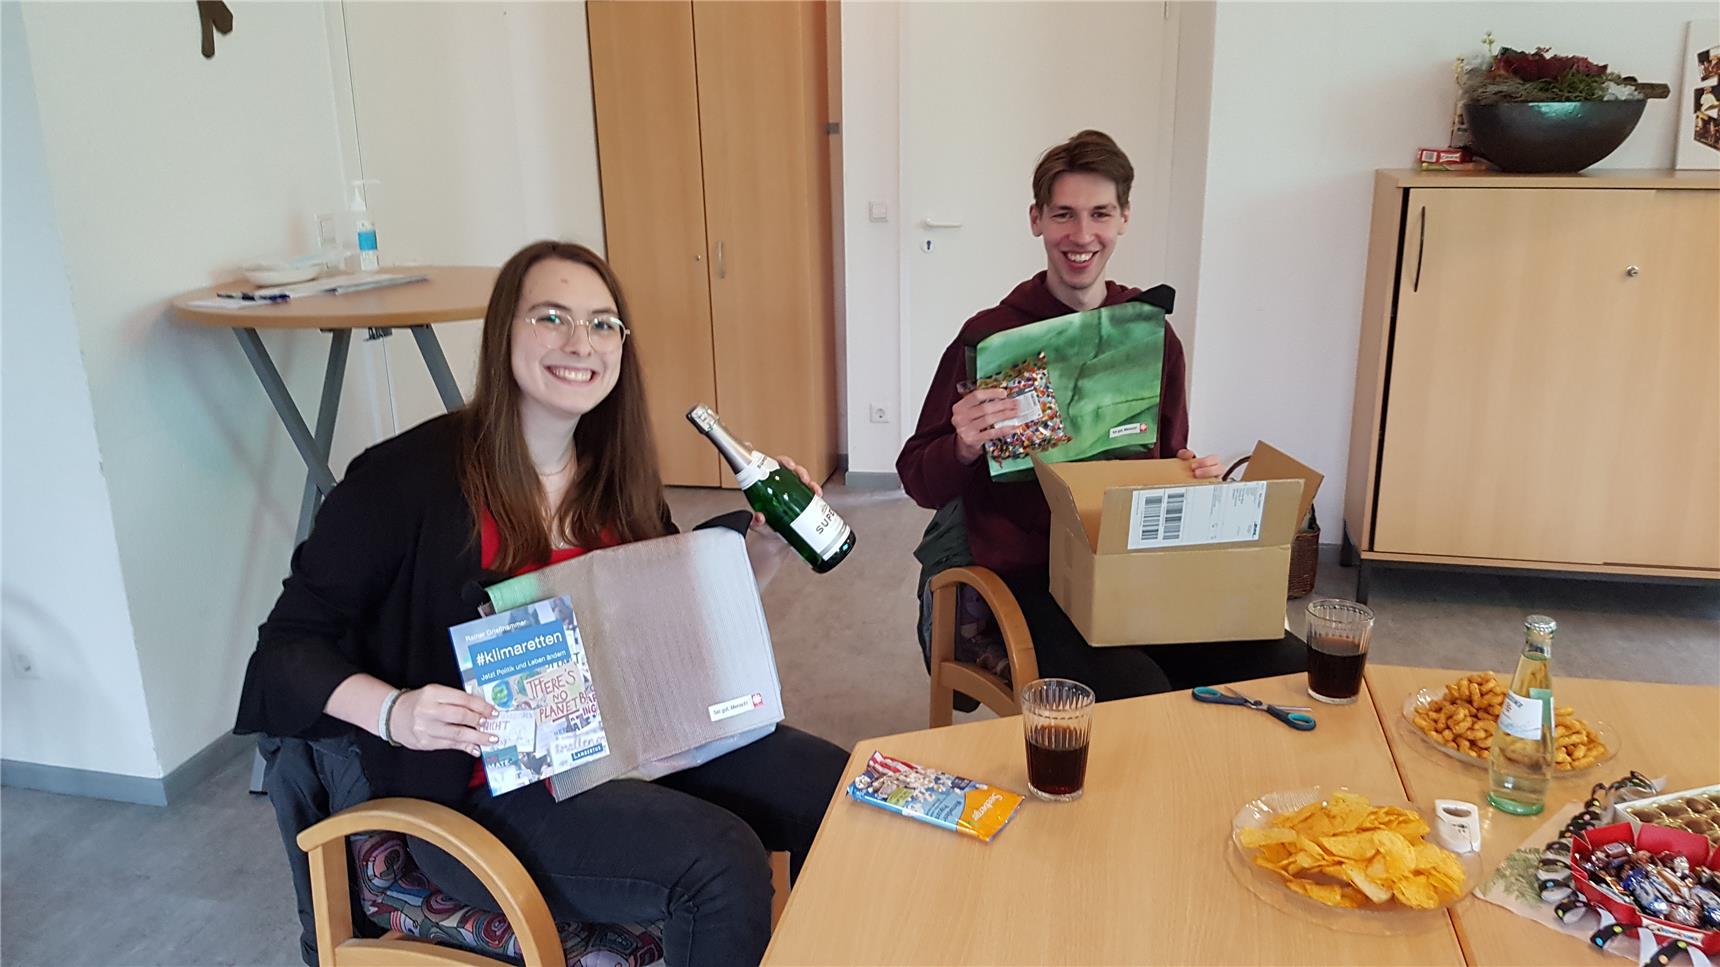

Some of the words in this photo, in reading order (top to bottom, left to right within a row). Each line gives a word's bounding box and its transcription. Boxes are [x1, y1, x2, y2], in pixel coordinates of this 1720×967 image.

[476, 632, 563, 666] #klimaretten
[481, 671, 497, 681] Jetzt
[497, 666, 515, 676] Politik
[516, 661, 527, 670] und
[527, 655, 546, 666] Leben
[526, 668, 576, 701] THERE'S
[553, 689, 568, 703] NO
[539, 696, 578, 723] PLANET
